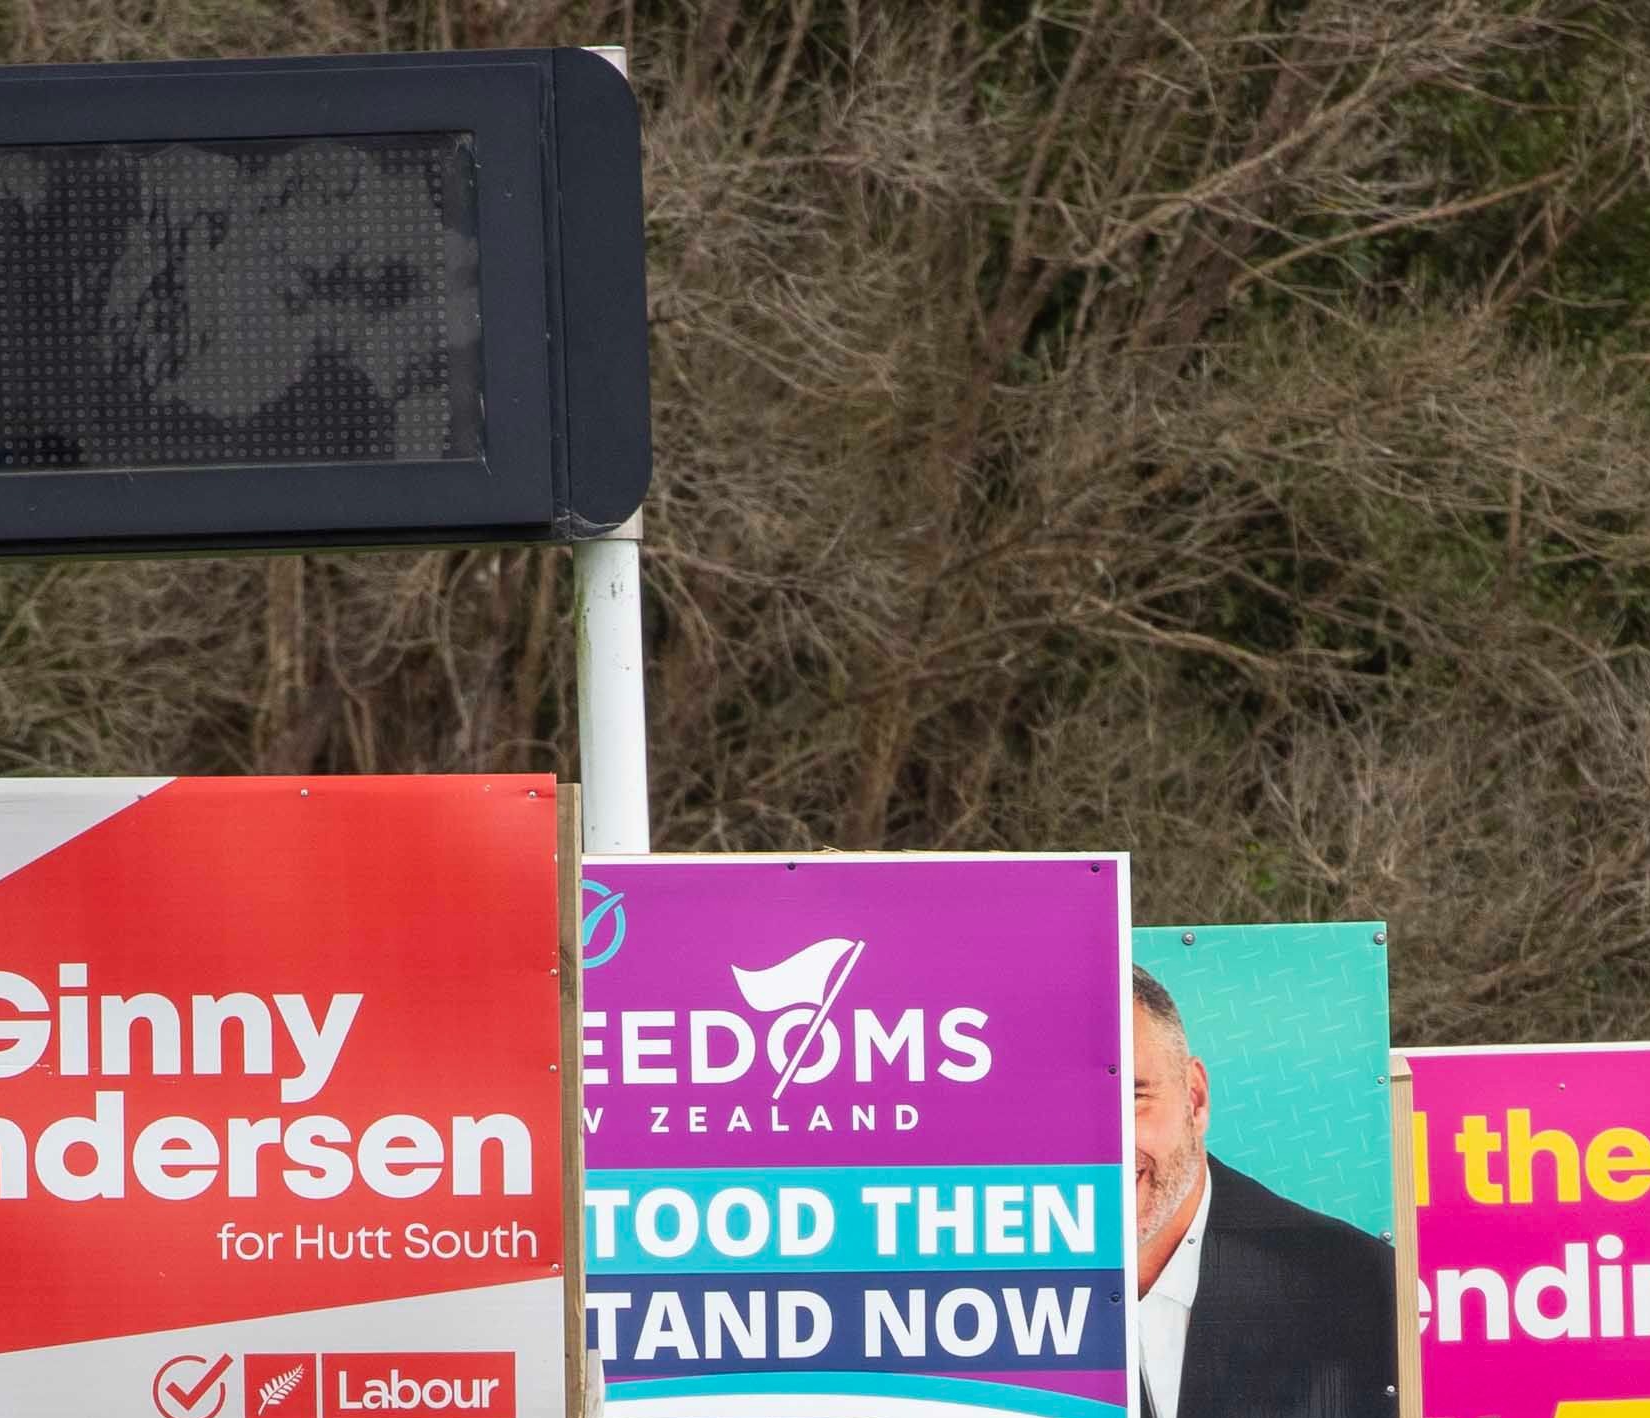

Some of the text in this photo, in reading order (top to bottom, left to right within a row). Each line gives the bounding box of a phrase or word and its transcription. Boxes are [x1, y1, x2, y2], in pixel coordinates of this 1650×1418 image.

[651, 1105, 918, 1132] ZEALAND
[217, 1222, 536, 1260] for Hutt South
[585, 1184, 1095, 1258] TOOD THEN
[586, 1288, 1091, 1360] TAND NOW
[339, 1369, 499, 1409] Labour
